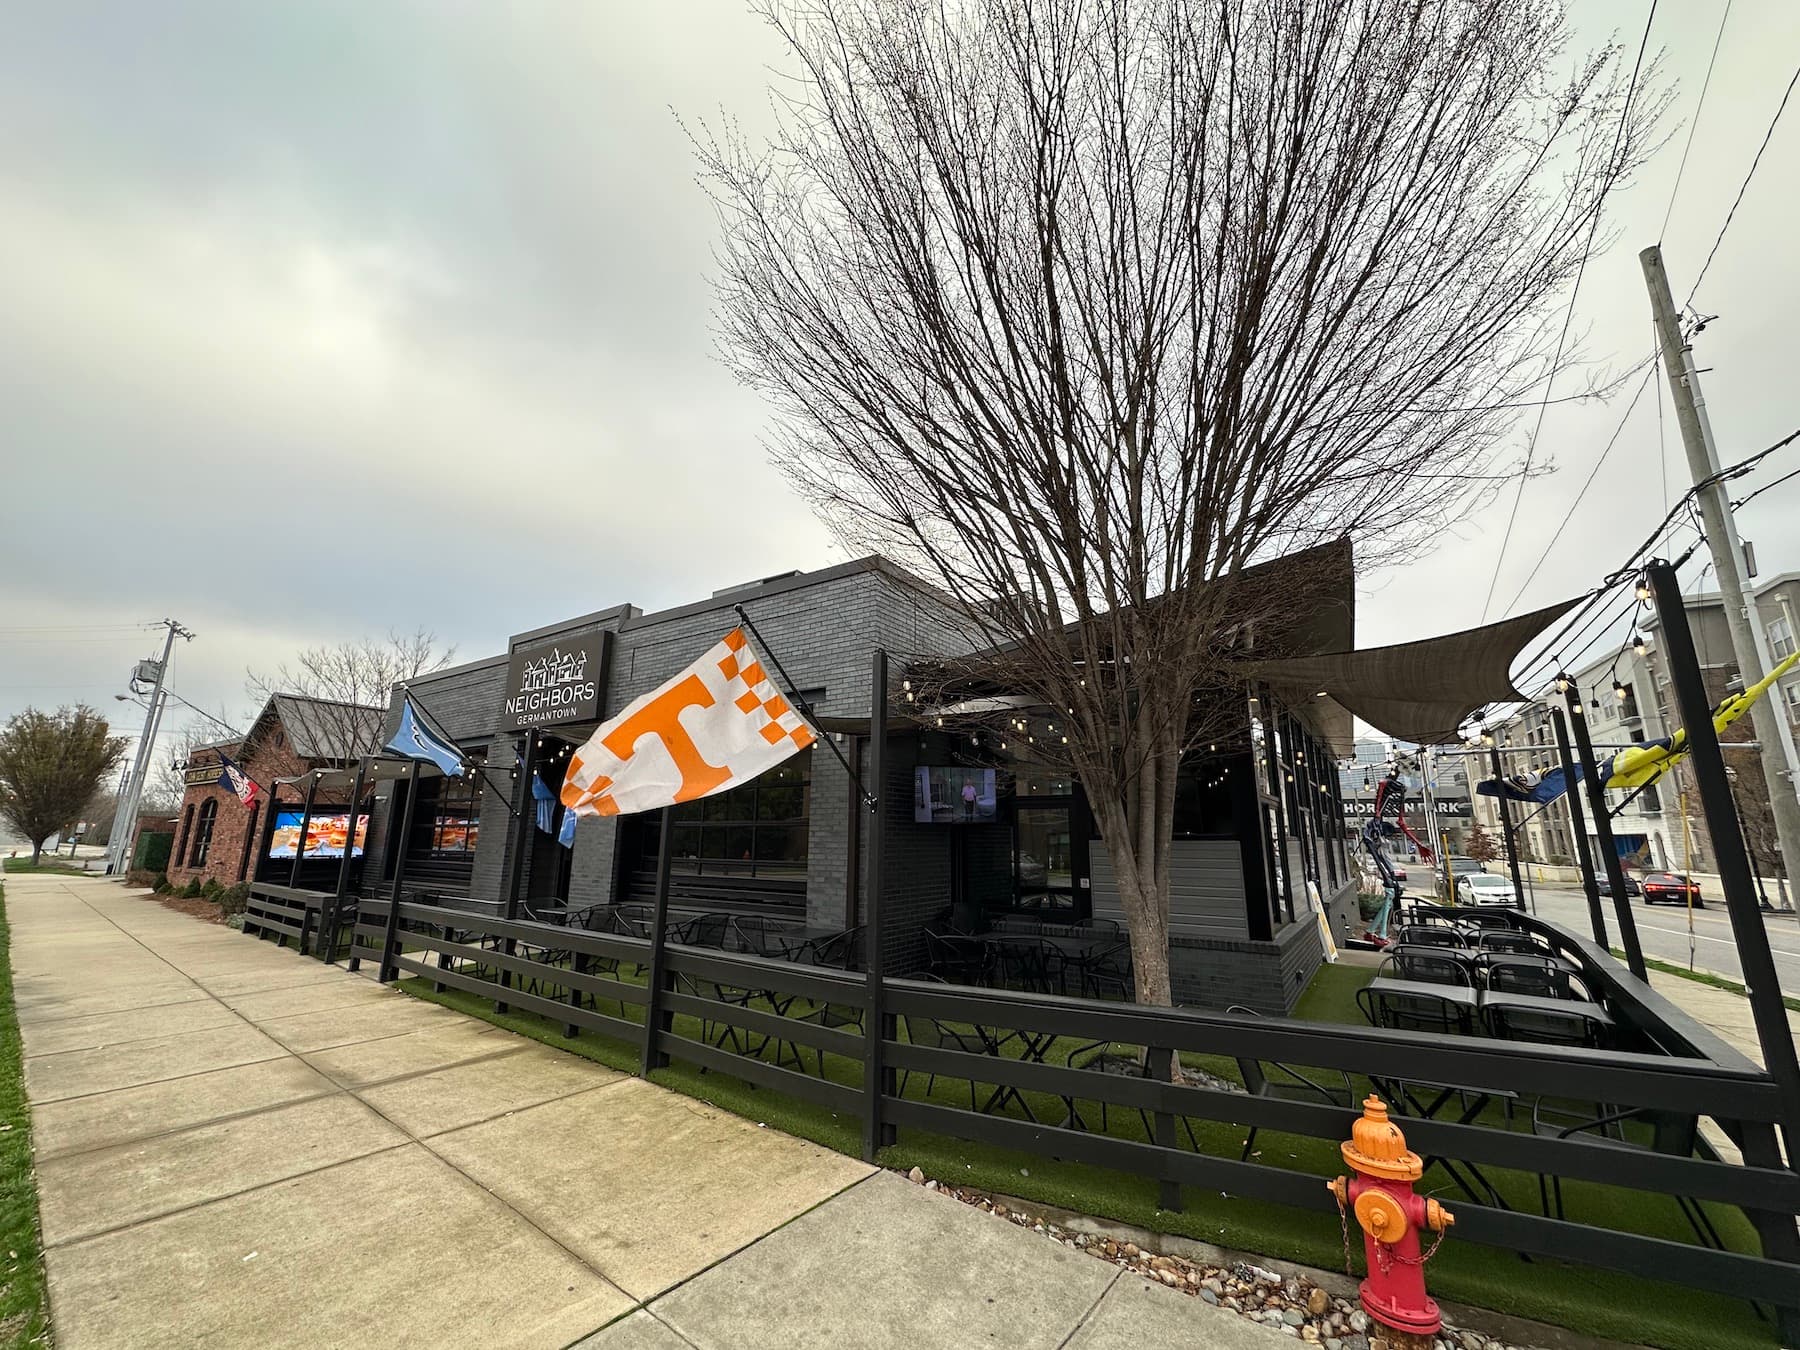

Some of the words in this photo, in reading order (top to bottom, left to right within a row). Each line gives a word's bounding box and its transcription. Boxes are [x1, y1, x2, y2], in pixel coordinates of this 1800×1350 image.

[505, 682, 595, 714] NEIGHBORS
[517, 707, 577, 725] GERMANTOWN
[601, 674, 733, 803] T
